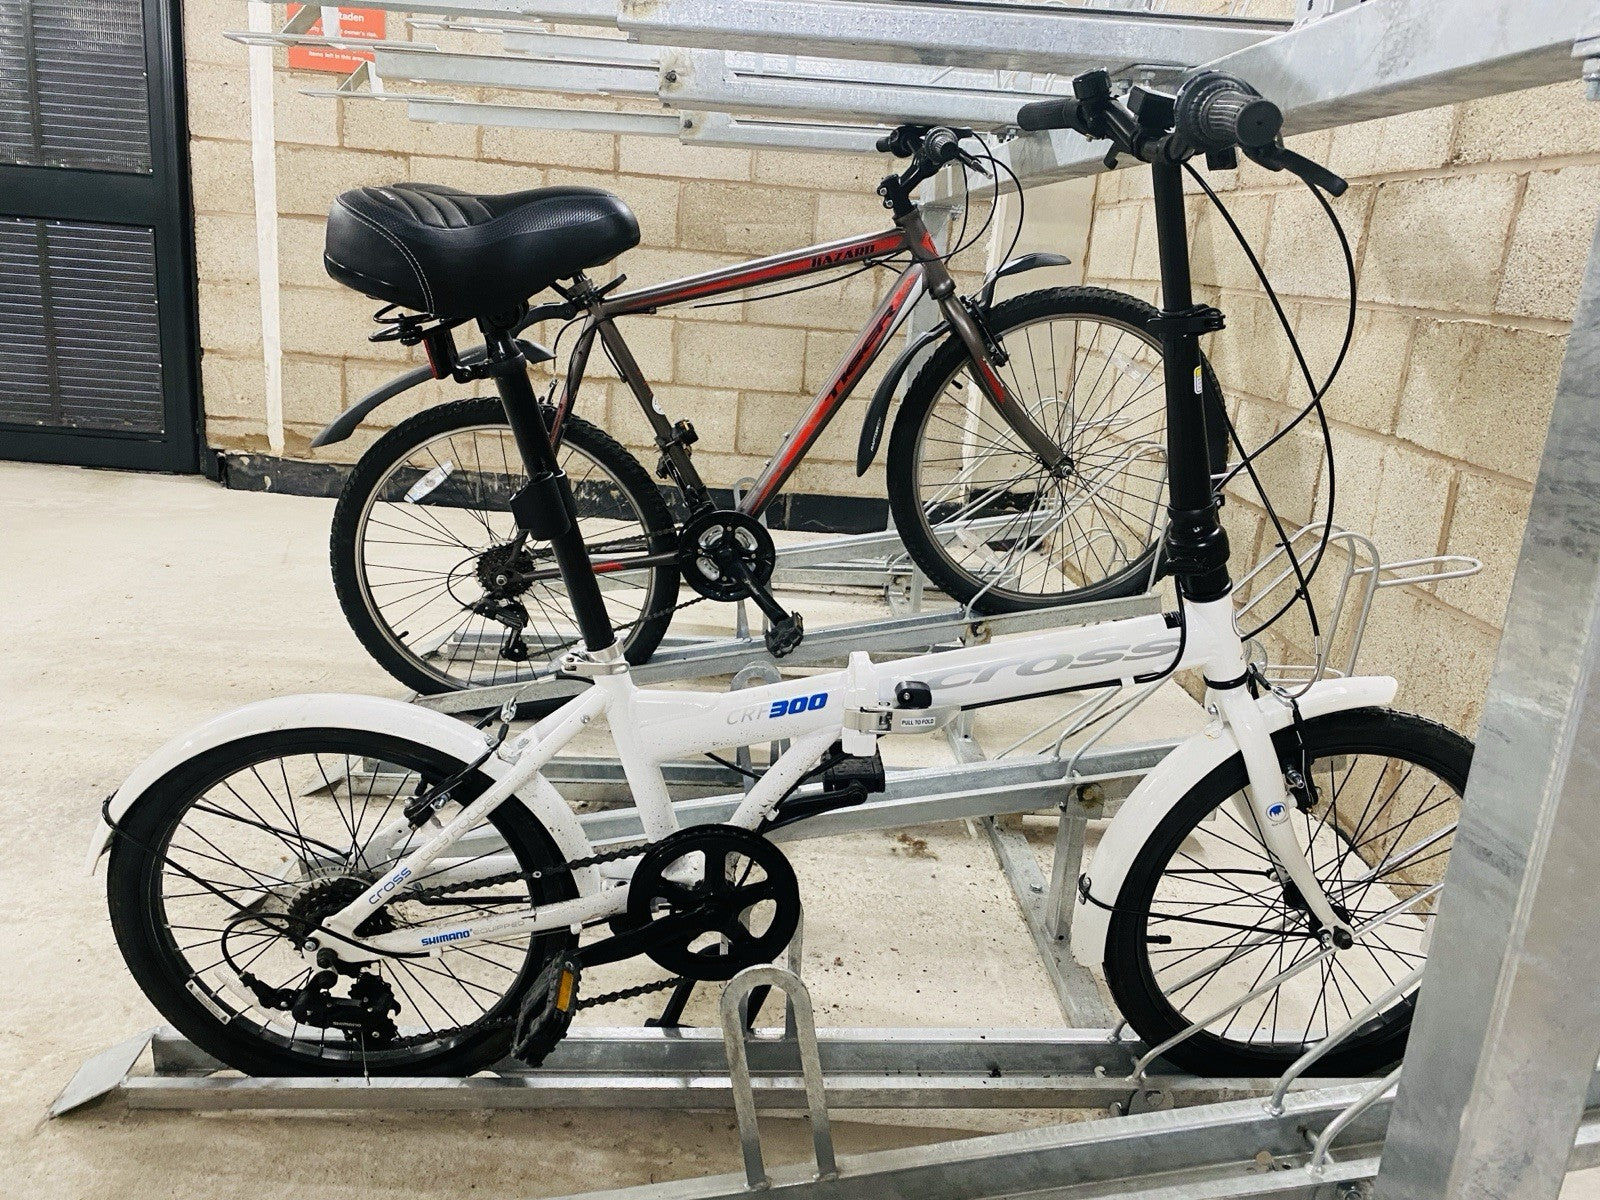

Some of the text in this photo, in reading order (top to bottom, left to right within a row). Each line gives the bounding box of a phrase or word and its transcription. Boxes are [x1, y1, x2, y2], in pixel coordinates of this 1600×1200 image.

[338, 11, 364, 22] taden
[811, 244, 875, 267] HAZARD
[928, 636, 1181, 690] cross
[368, 867, 412, 905] cross
[421, 931, 471, 946] SHIMANO
